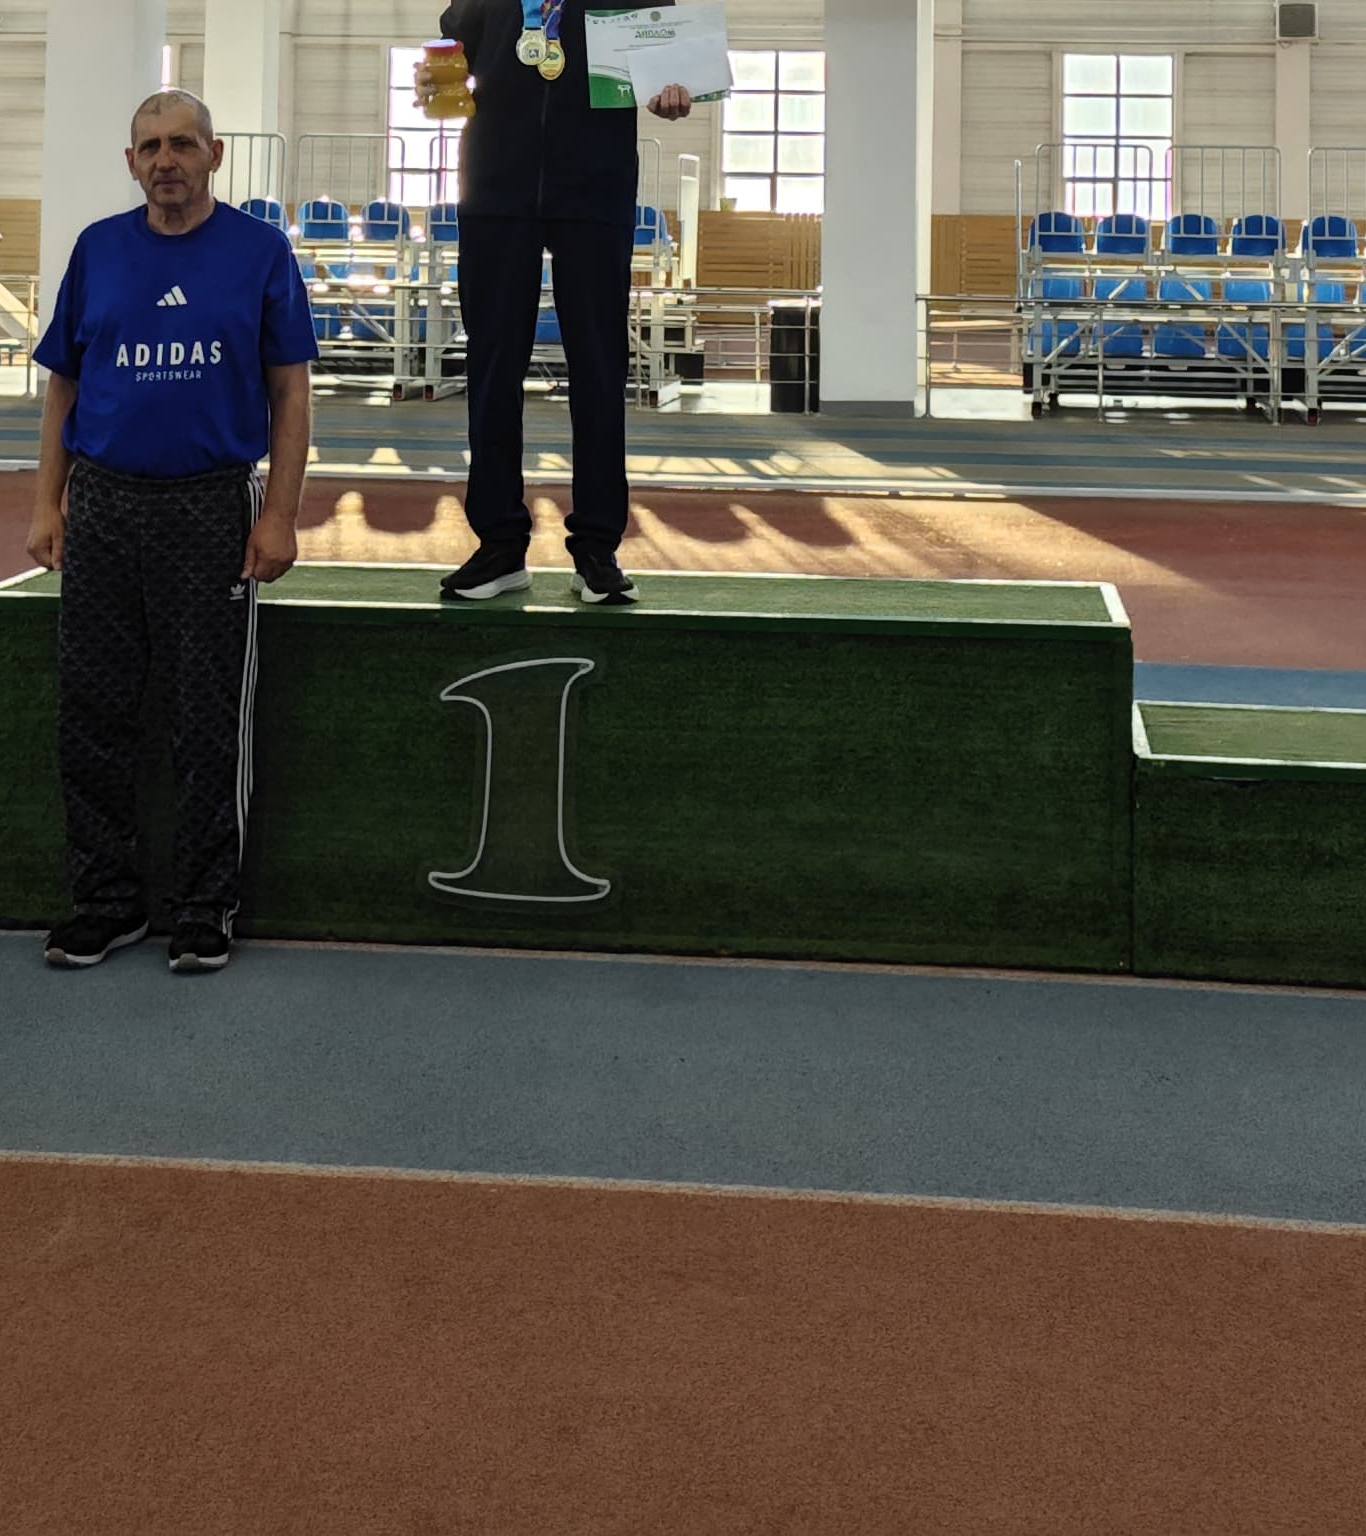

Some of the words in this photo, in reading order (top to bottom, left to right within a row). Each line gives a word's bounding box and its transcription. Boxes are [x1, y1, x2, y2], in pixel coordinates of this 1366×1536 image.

[116, 340, 222, 367] ADIDAS
[135, 369, 202, 382] SPORTSWEAR
[428, 657, 611, 902] 1
